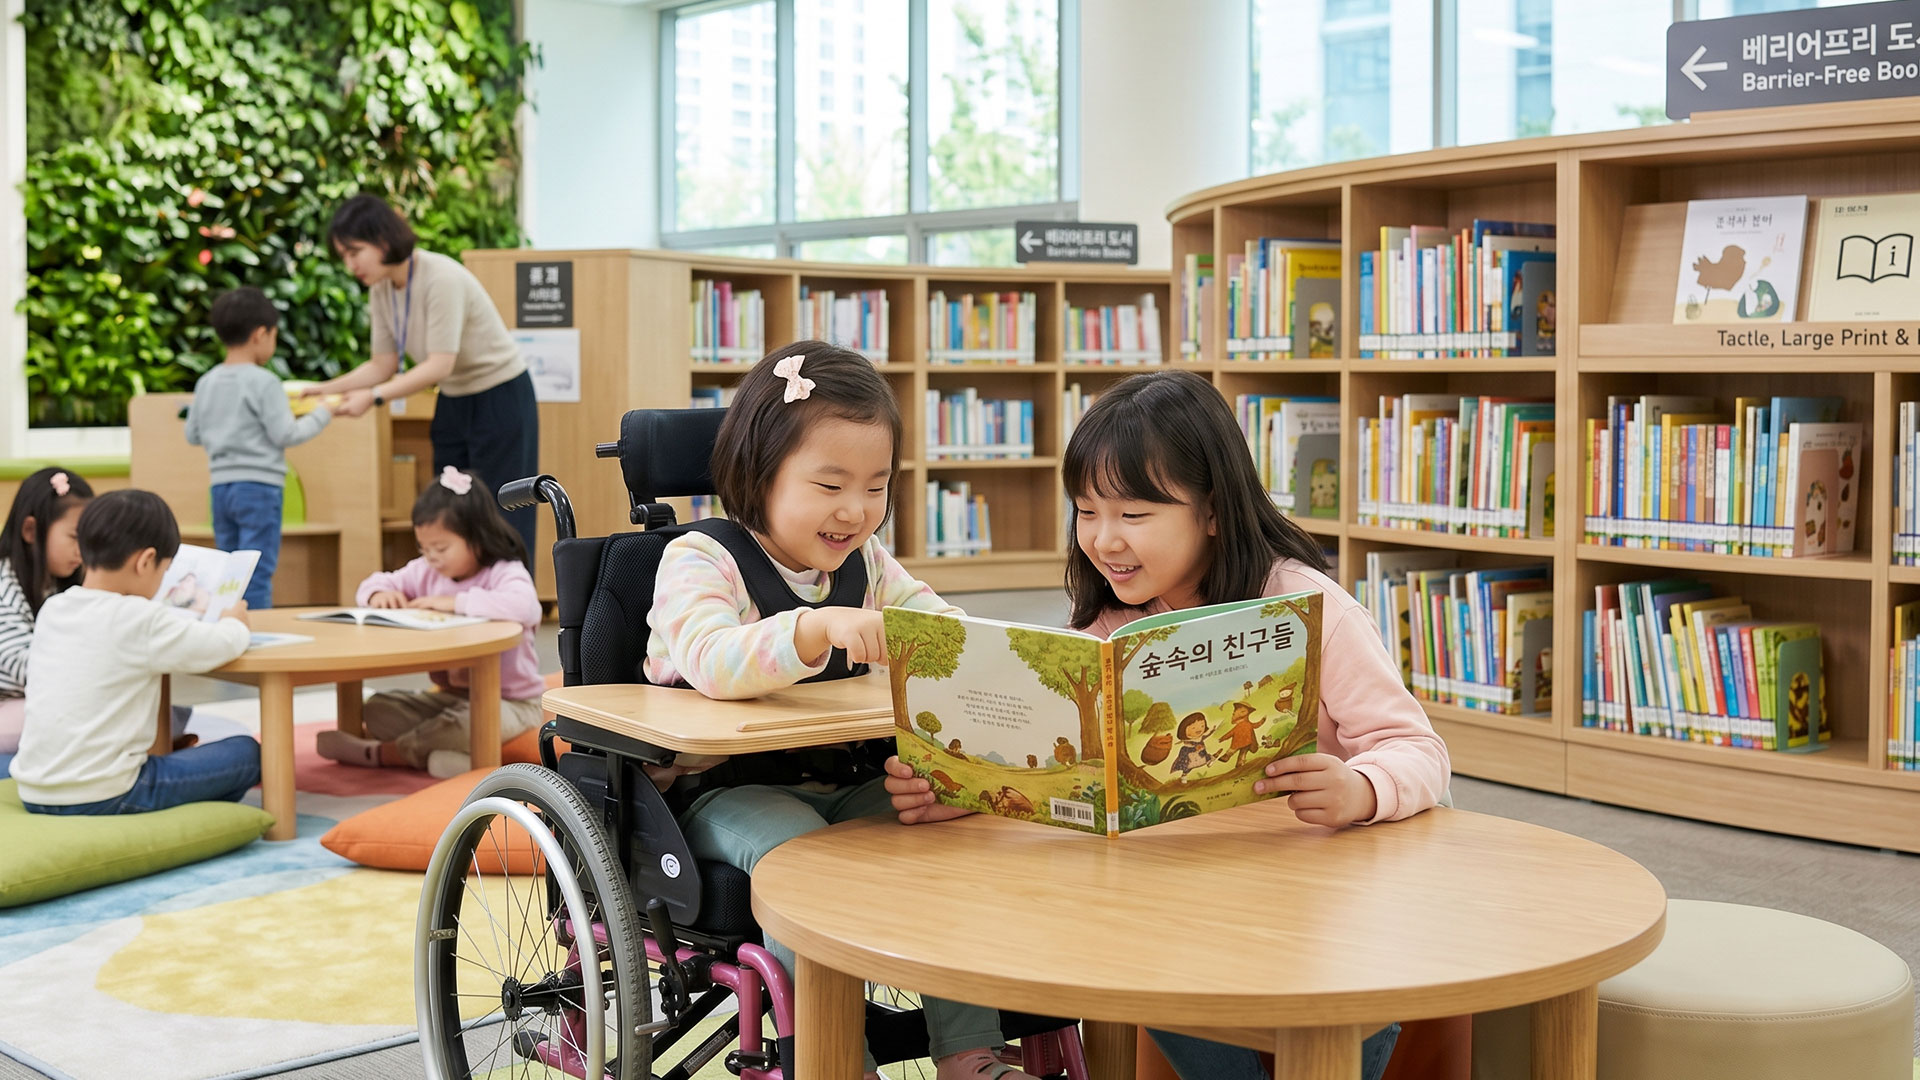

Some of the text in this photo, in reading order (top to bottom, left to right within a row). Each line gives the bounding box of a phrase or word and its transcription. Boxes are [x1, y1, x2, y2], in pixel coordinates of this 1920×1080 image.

[1742, 22, 1920, 66] 베리어프리 도
[1742, 57, 1920, 92] Barrier-Free Boo
[1717, 330, 1775, 348] Tactle,
[1782, 330, 1834, 350] Large
[1841, 329, 1888, 346] Print
[1895, 329, 1909, 346] &
[1138, 621, 1295, 680] 숲속의 친구들
